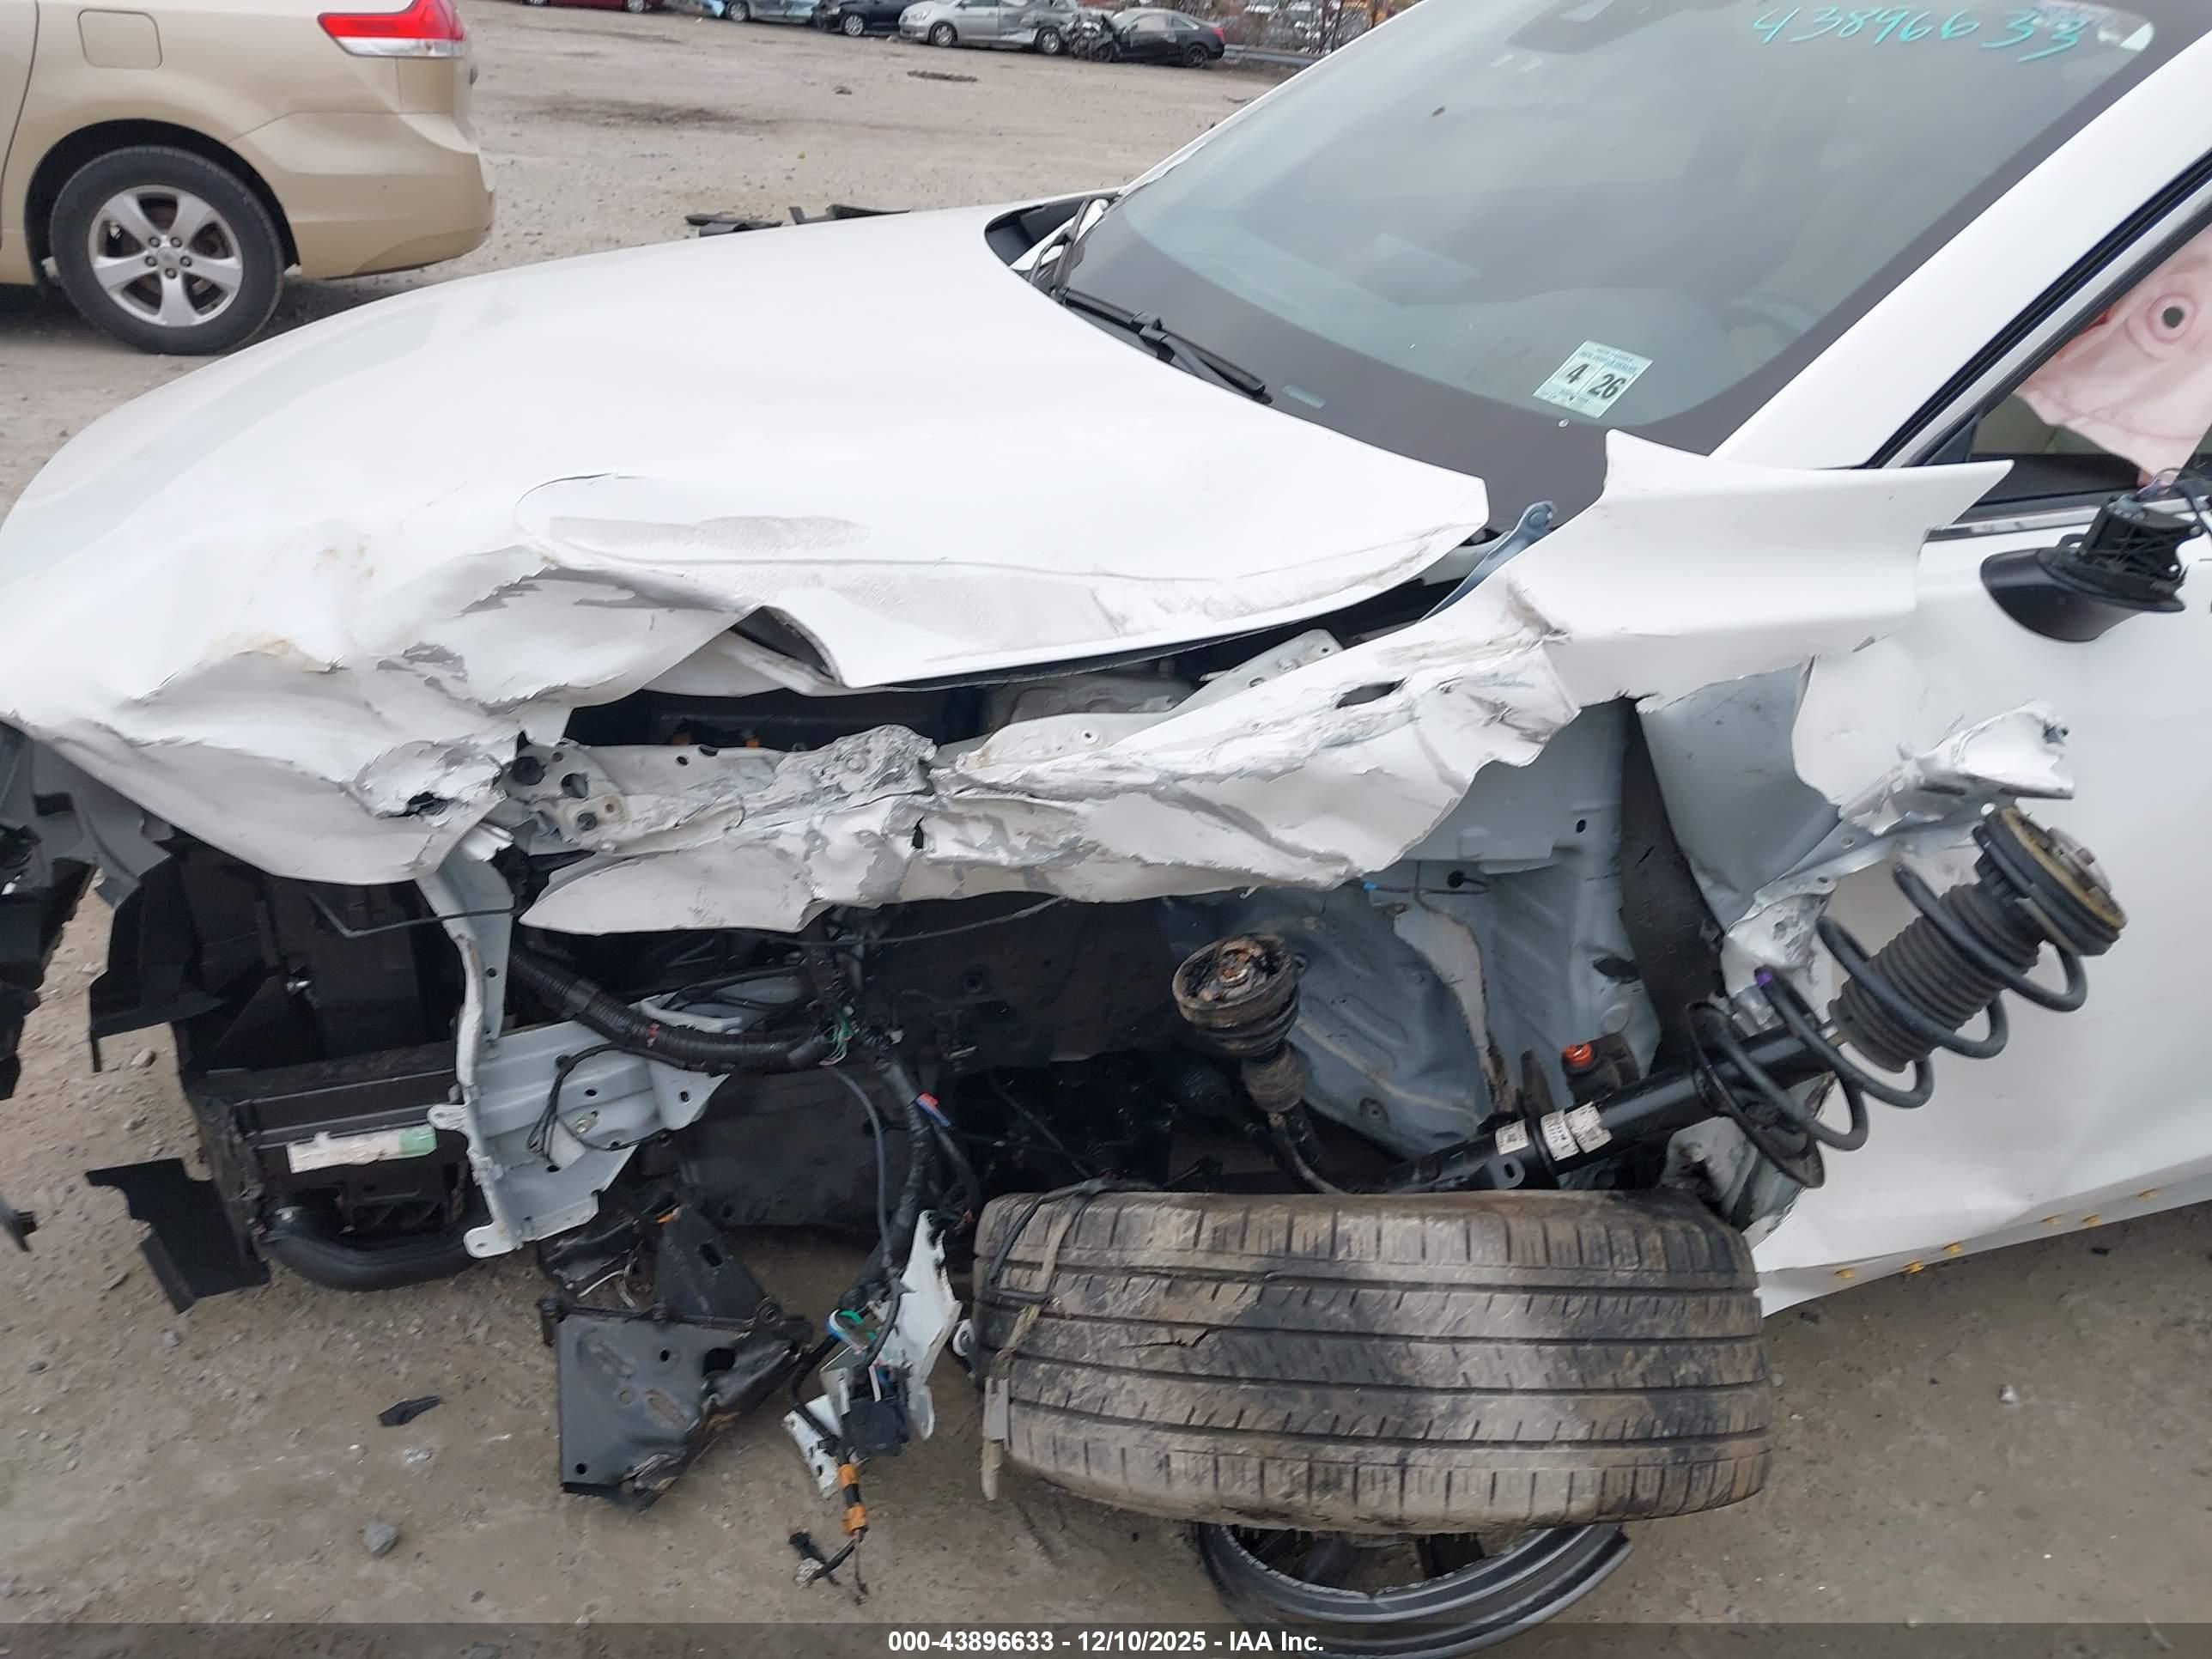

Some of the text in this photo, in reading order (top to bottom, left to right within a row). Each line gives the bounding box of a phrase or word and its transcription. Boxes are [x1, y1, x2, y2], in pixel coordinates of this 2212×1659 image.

[1753, 7, 2089, 63] 43896633
[1565, 363, 1590, 384] 4
[1588, 373, 1627, 399] 26
